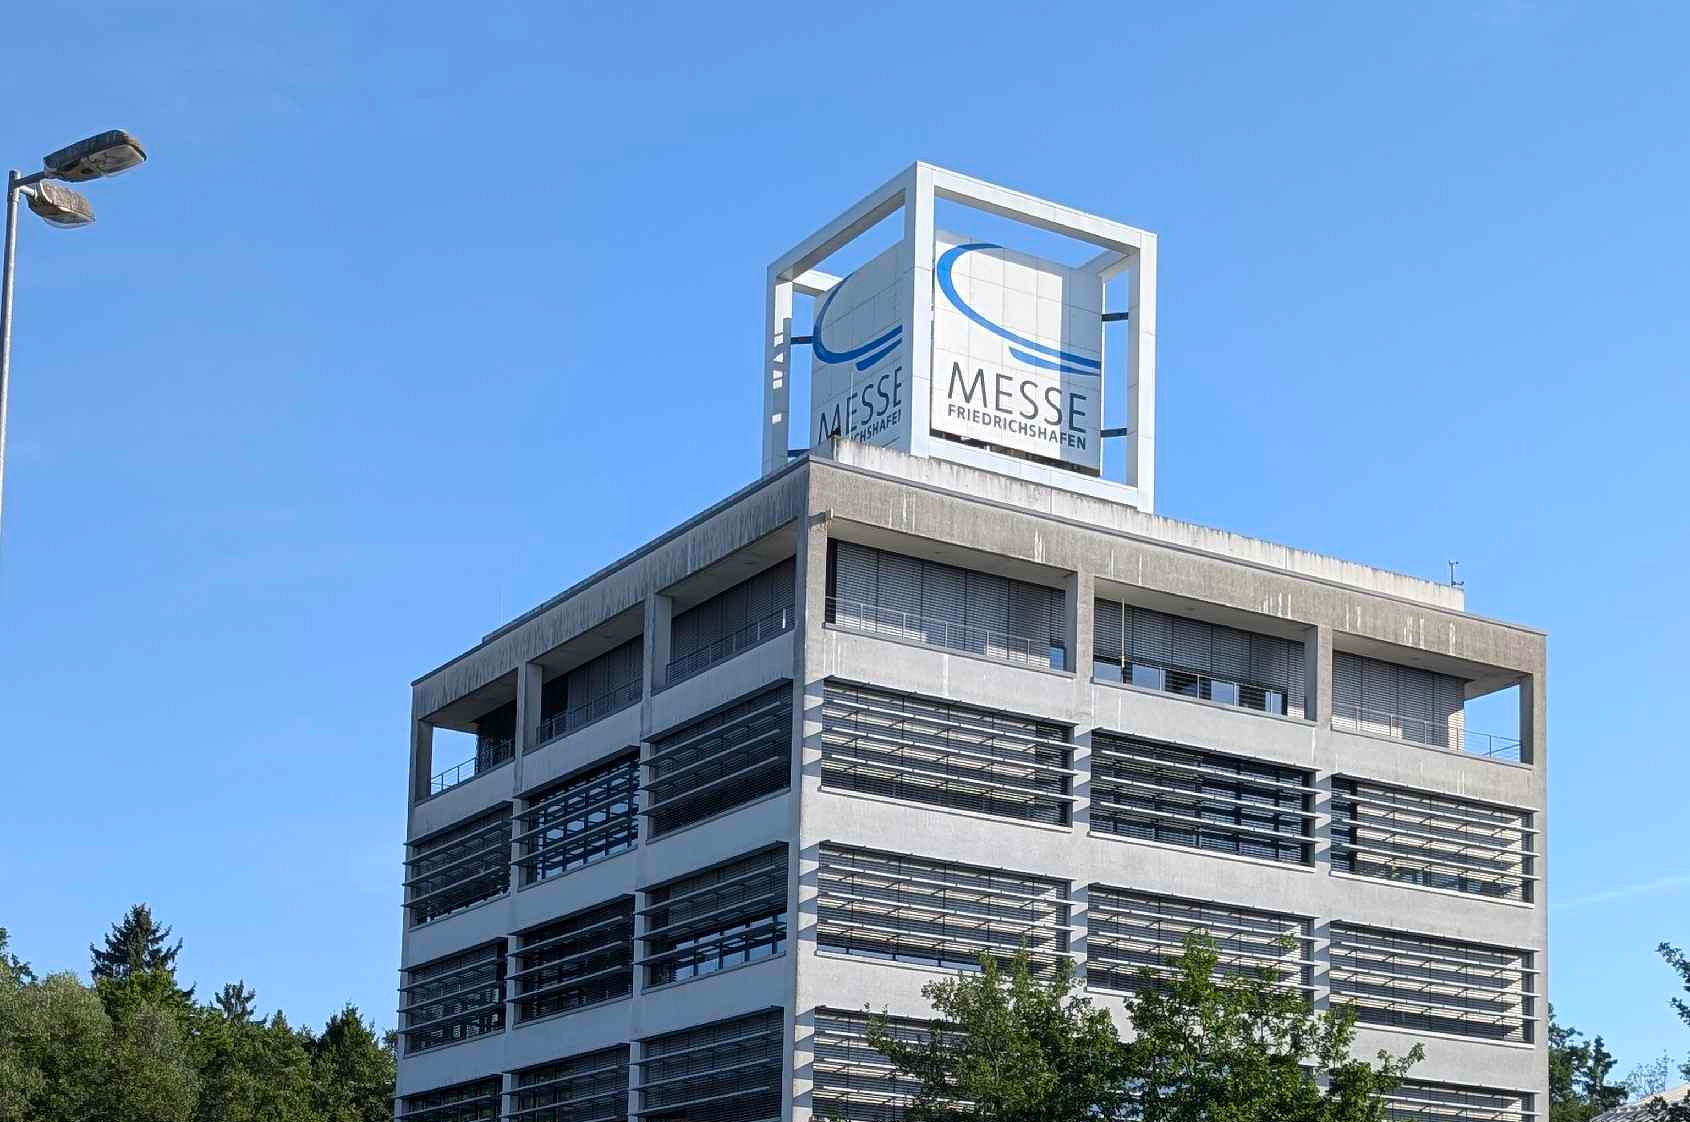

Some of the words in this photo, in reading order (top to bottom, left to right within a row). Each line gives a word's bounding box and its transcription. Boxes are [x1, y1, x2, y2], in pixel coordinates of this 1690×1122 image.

[817, 365, 902, 446] MESSE
[947, 361, 1088, 433] MESSE
[947, 403, 1087, 450] FRIEDRICHSHAFEN
